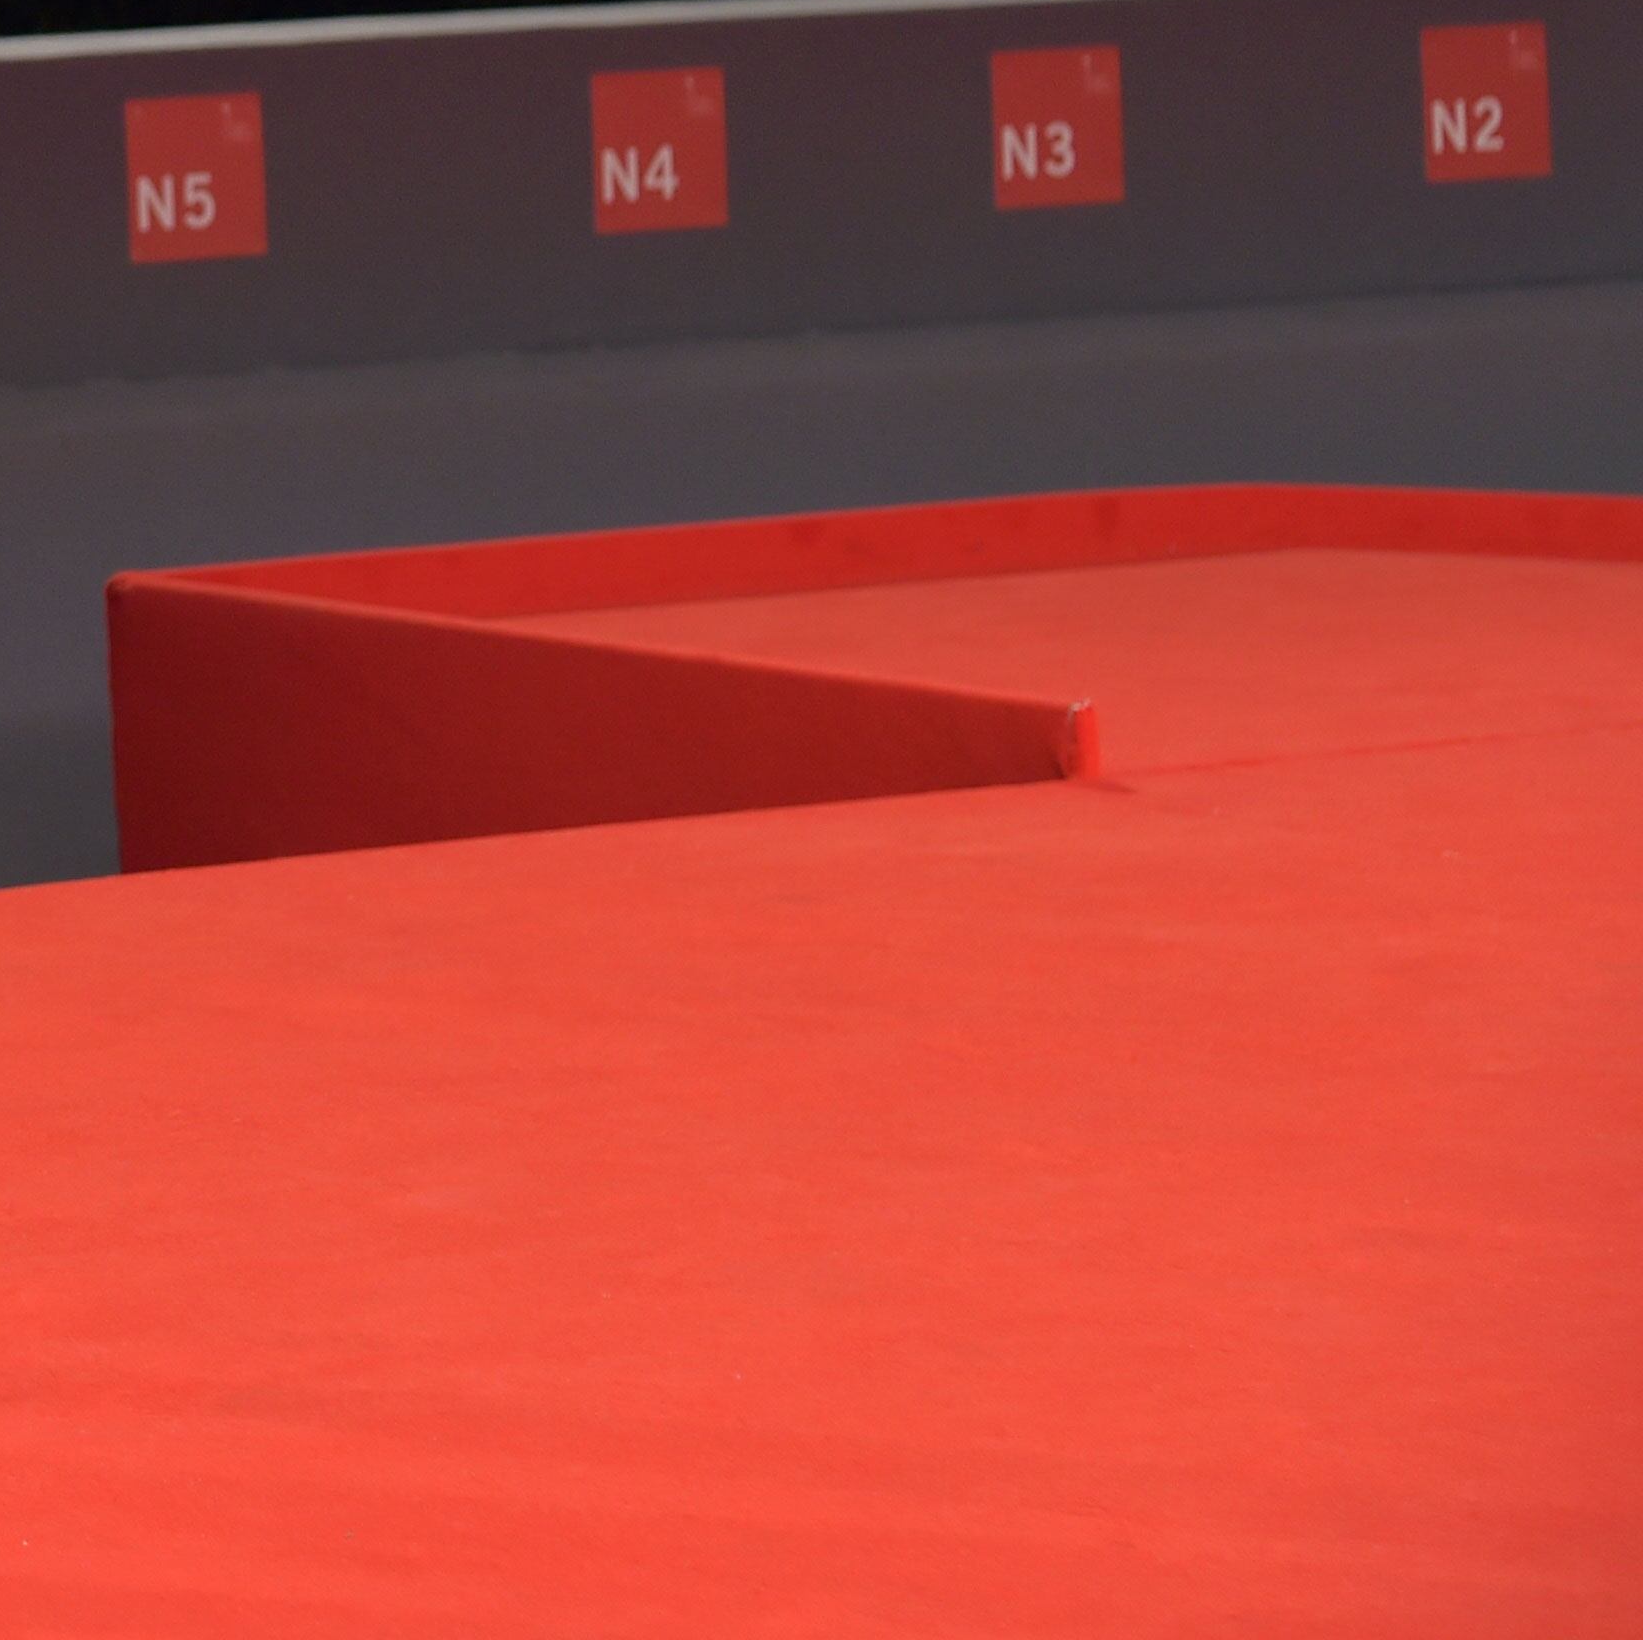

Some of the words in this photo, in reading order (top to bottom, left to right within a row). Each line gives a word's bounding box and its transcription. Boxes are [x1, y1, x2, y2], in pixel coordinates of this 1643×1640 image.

[1000, 121, 1076, 181] N3
[1431, 96, 1505, 156] N2
[135, 171, 217, 234] N5
[600, 144, 679, 205] N4
